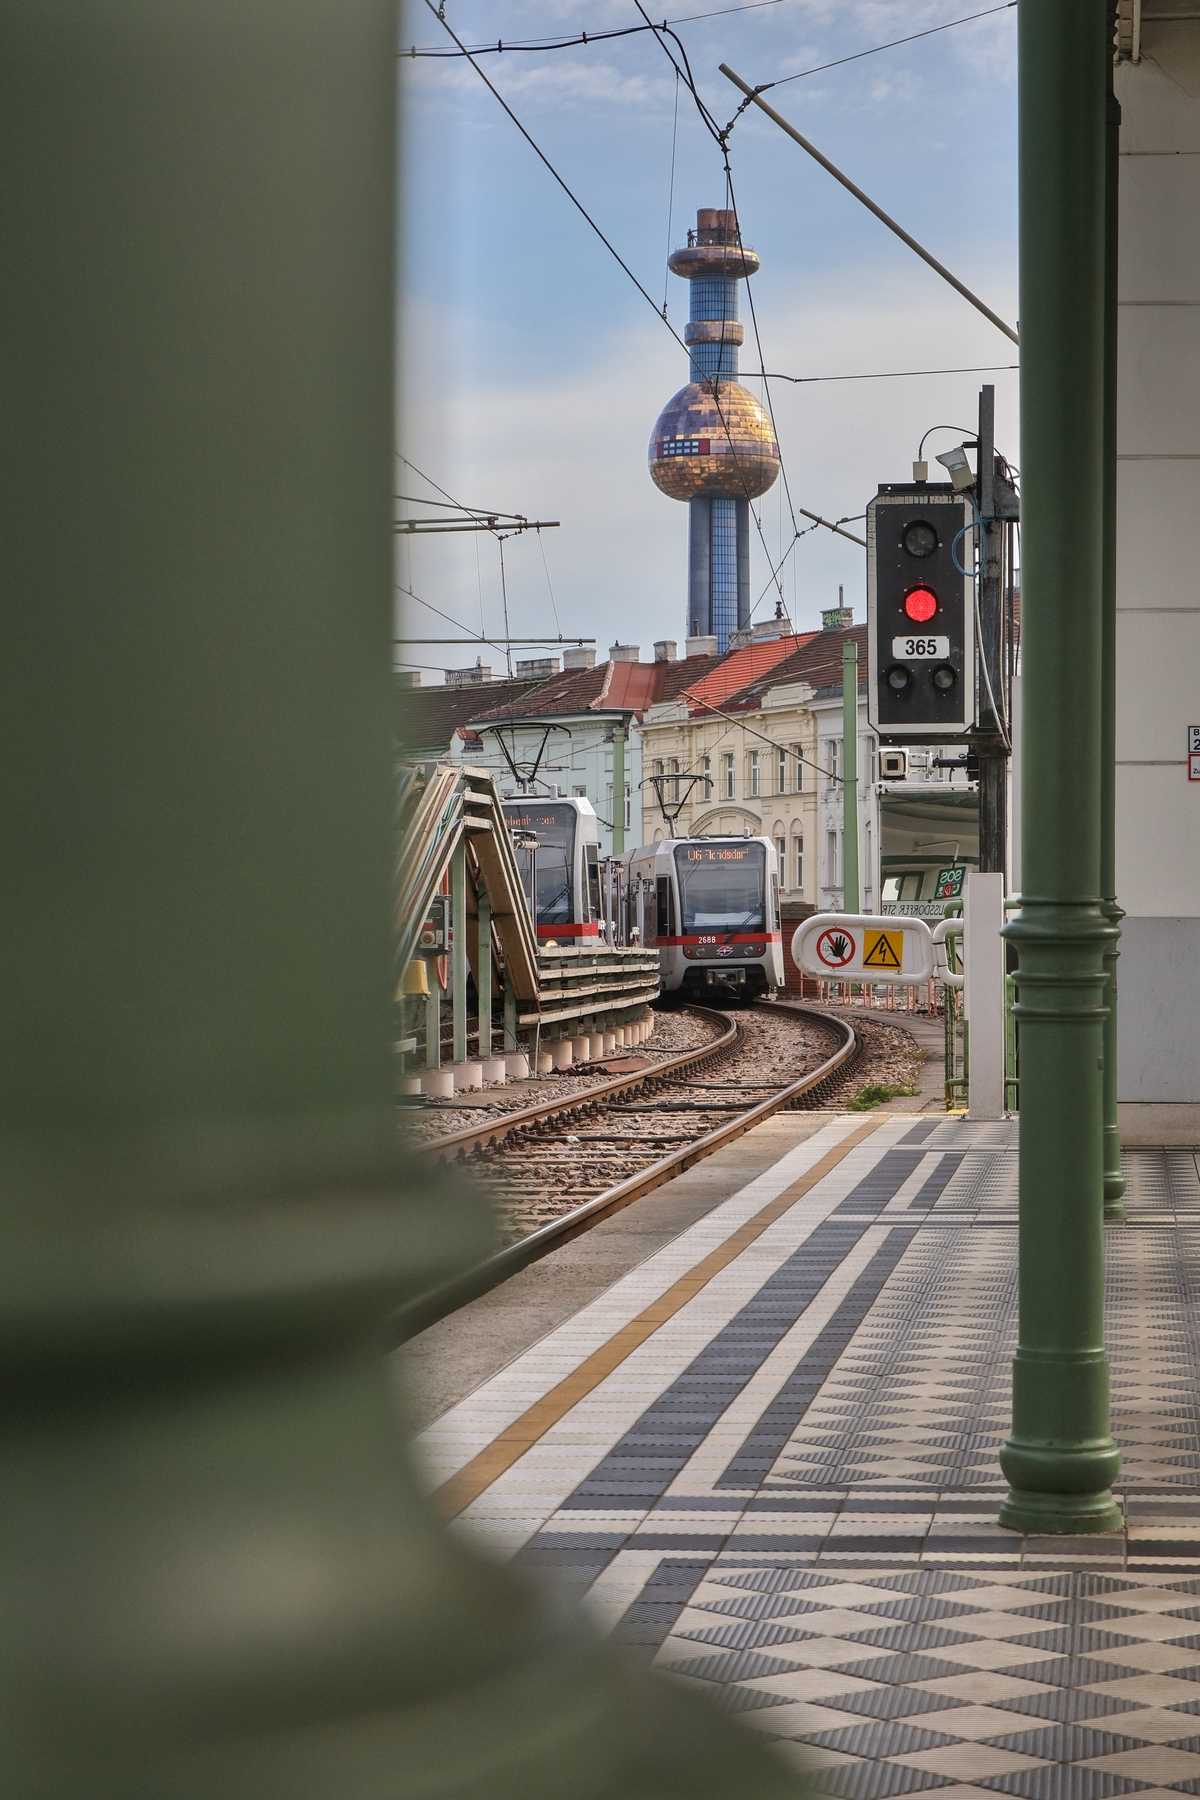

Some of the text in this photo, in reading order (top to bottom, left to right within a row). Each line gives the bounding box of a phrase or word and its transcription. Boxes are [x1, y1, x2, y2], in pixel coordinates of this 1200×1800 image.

[905, 639, 937, 655] 365
[687, 849, 702, 861] U6
[698, 936, 716, 945] 2688
